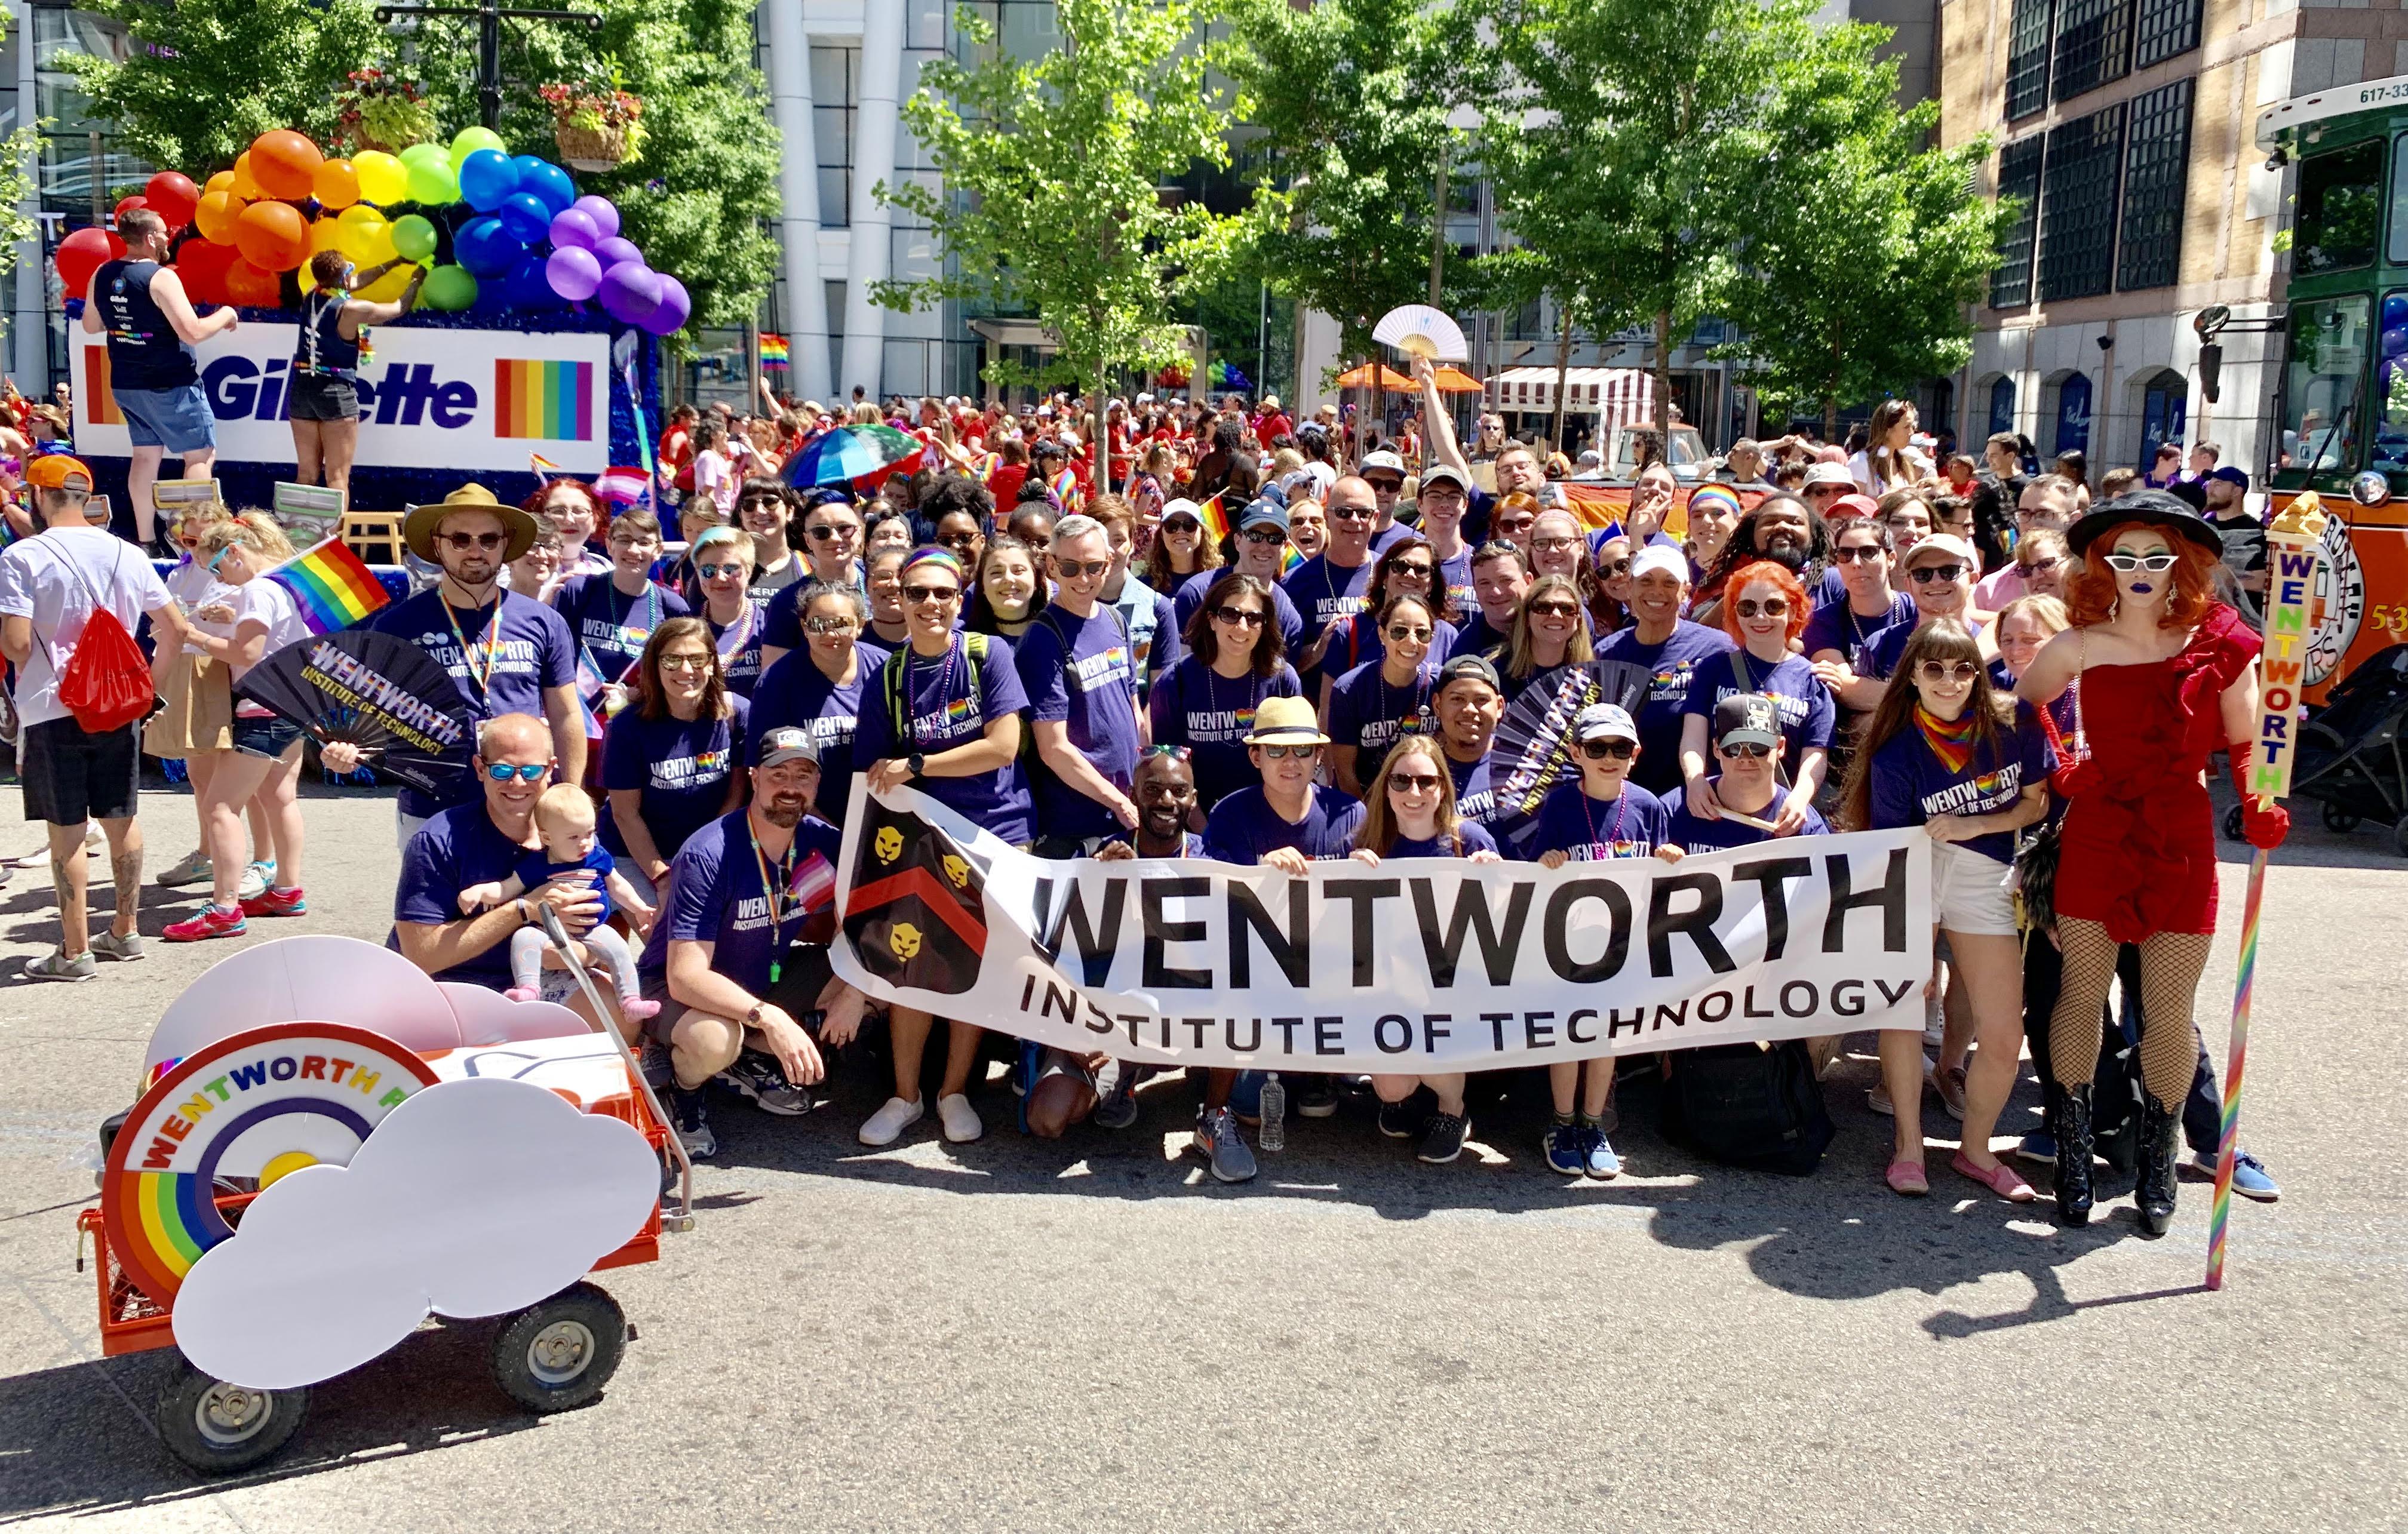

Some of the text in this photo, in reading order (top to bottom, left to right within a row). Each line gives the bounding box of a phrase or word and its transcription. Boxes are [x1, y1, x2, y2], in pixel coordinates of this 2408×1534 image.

[300, 665, 444, 756] INSTITUTE OF TECHNOLOGY
[312, 641, 462, 745] WENTWORTH
[2255, 553, 2315, 791] WENTWORTH
[1187, 729, 1223, 742] INSTITUTE
[1224, 729, 1233, 740] OF
[1497, 668, 1591, 808] WENTWORTH
[1521, 762, 1560, 816] INSTITUTE
[1552, 748, 1565, 764] OF
[1968, 801, 1979, 813] OF
[732, 915, 770, 931] INSTITUTE
[1031, 847, 1909, 989] WENTWORTH
[1020, 974, 1915, 1055] INSTITUTE OF TECHNOLOGY
[142, 1055, 382, 1169] WENTWORTH
